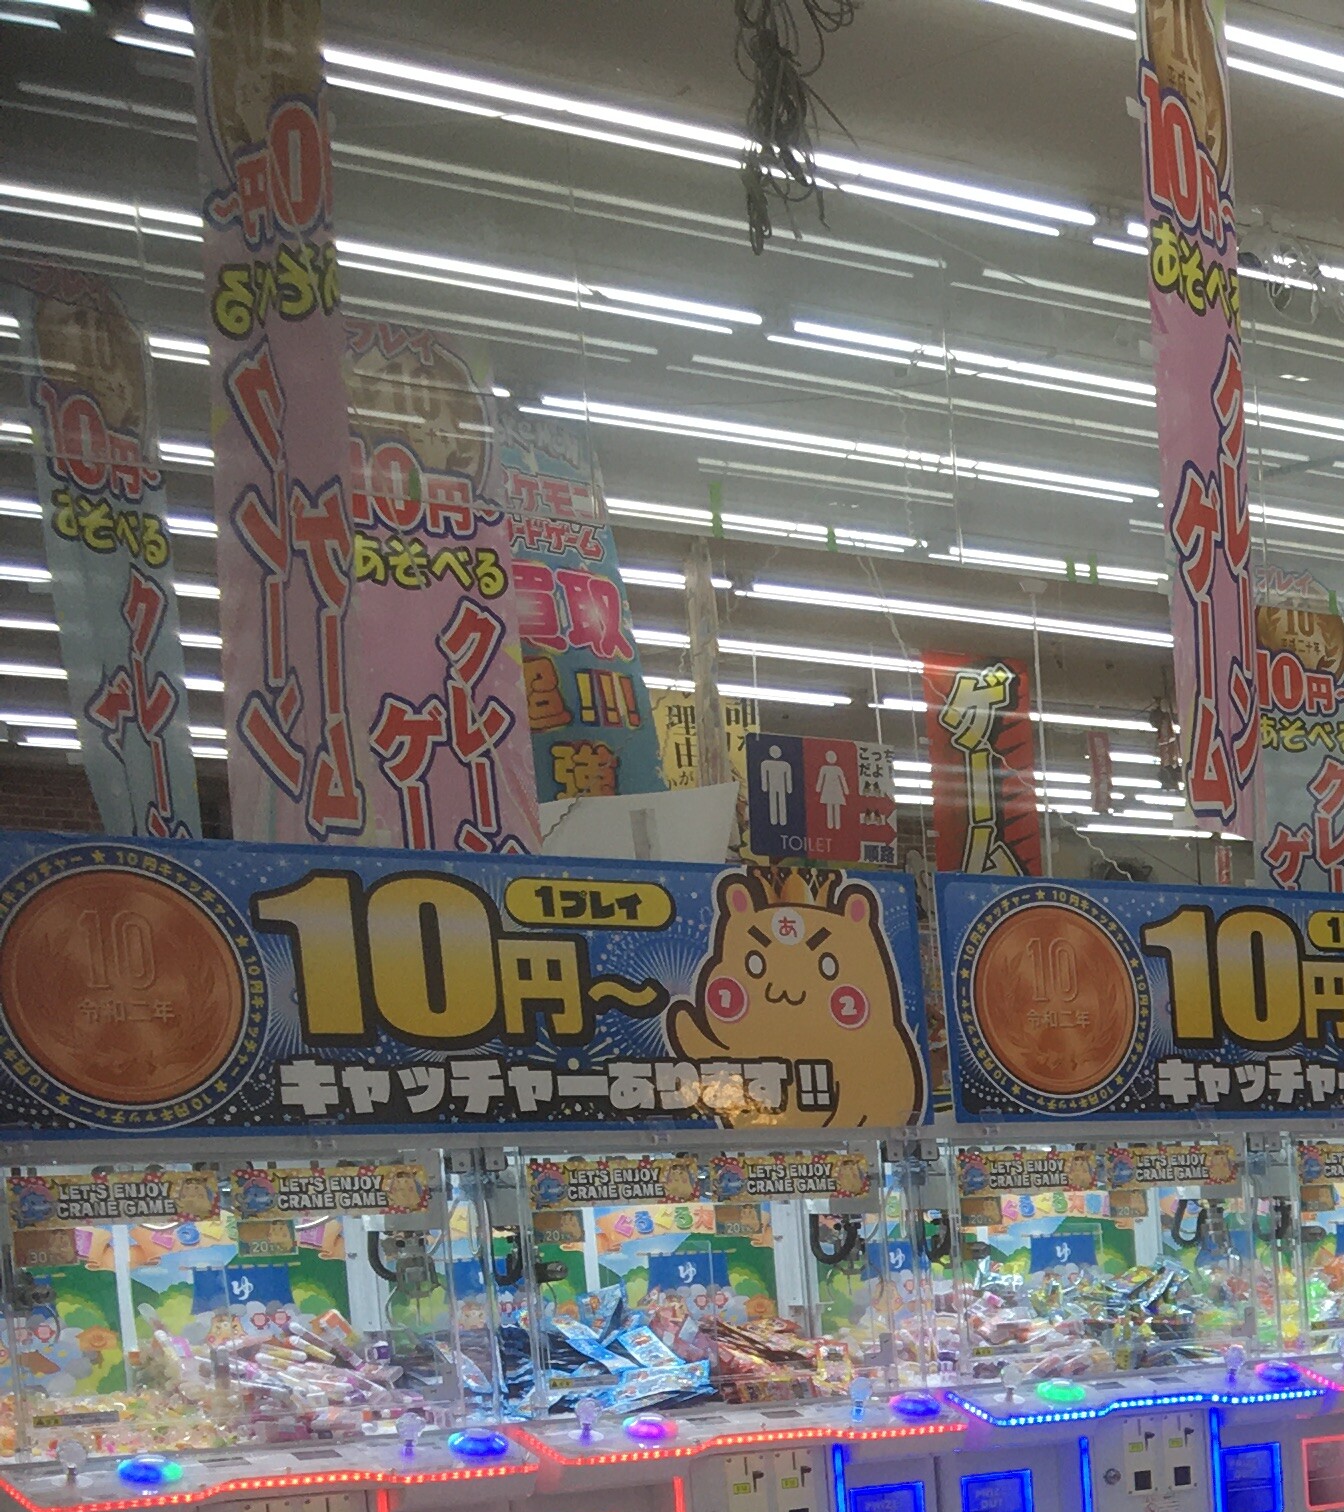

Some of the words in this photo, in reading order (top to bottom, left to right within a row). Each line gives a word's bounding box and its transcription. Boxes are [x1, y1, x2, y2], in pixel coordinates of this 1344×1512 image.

[780, 834, 833, 855] TOILET
[533, 884, 646, 923] 1プレイ
[76, 908, 156, 987] 10
[1025, 937, 1076, 1002] 10
[77, 997, 176, 1024] 令和二年
[748, 1164, 785, 1178] LET'S
[788, 1162, 833, 1177] ENJOY
[746, 1177, 793, 1194] CRANE
[795, 1177, 837, 1192] GAME
